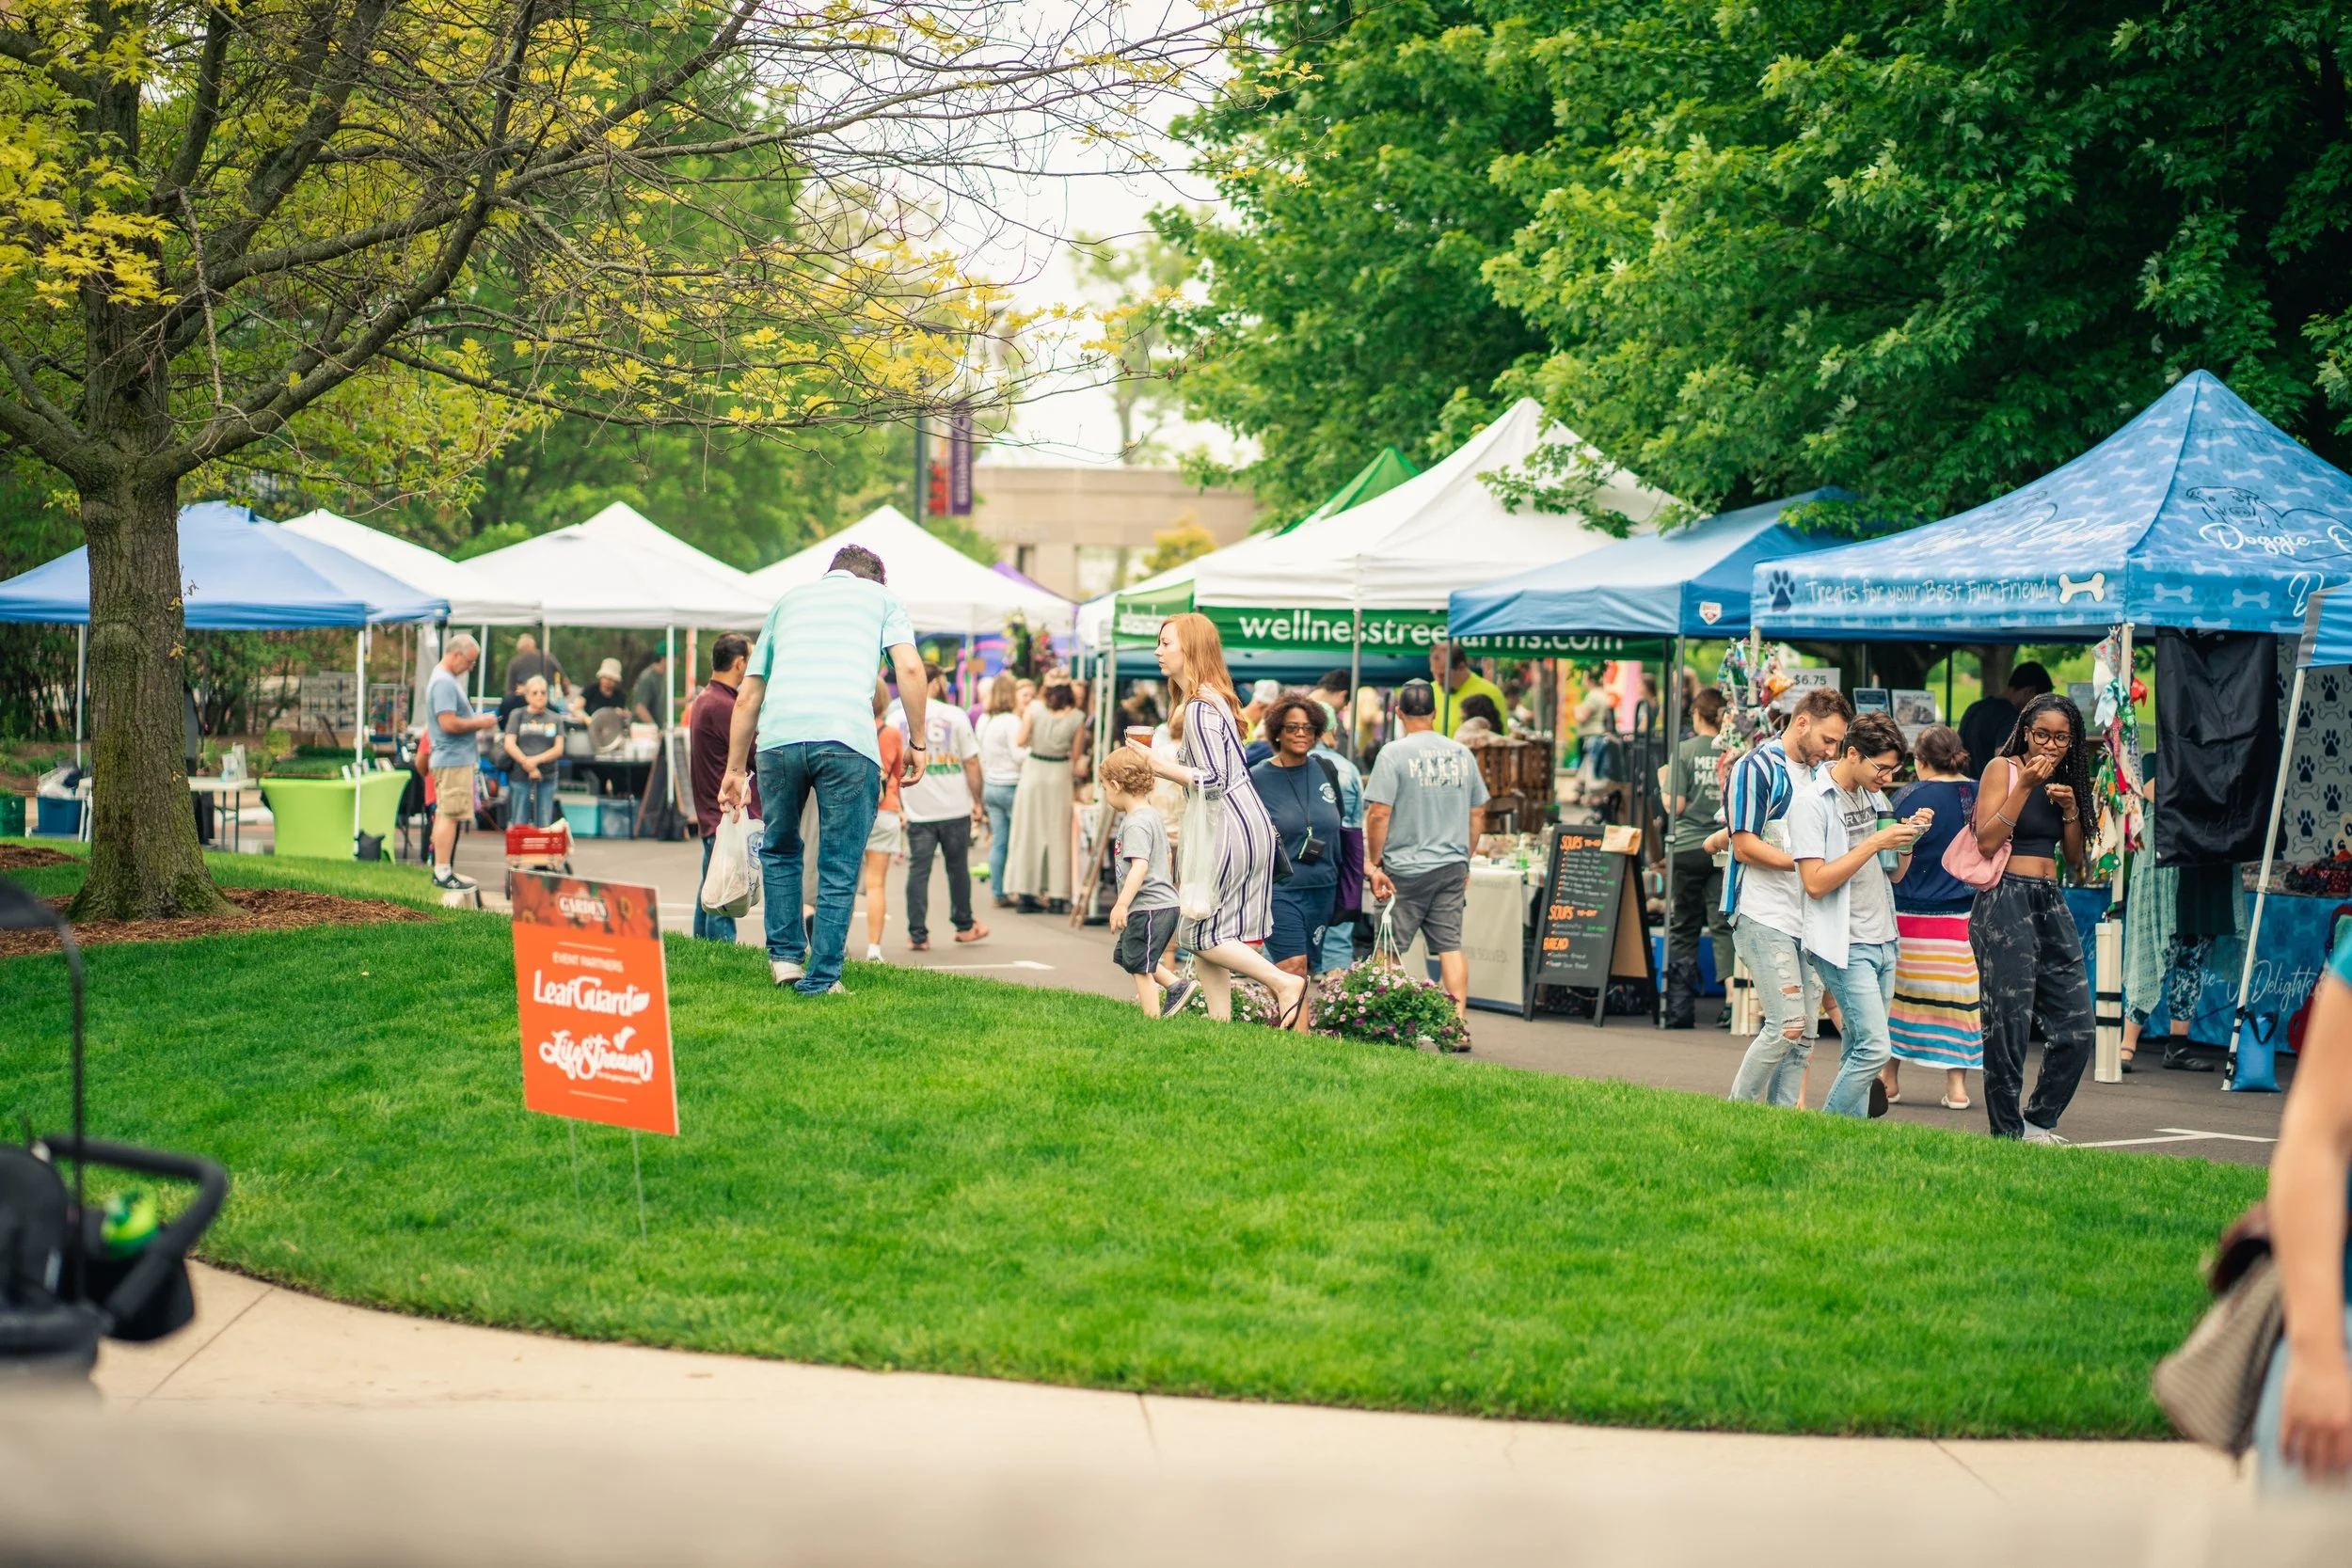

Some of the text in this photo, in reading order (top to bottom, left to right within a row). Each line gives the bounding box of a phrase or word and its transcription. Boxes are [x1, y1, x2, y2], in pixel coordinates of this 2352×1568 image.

[1805, 572, 2048, 609] Treats for your Best Fur Friend
[1793, 673, 1827, 686] $6.75
[1408, 756, 1470, 779] MARSH
[532, 969, 636, 1017] LeafGuard
[538, 1026, 654, 1083] LifeStream
